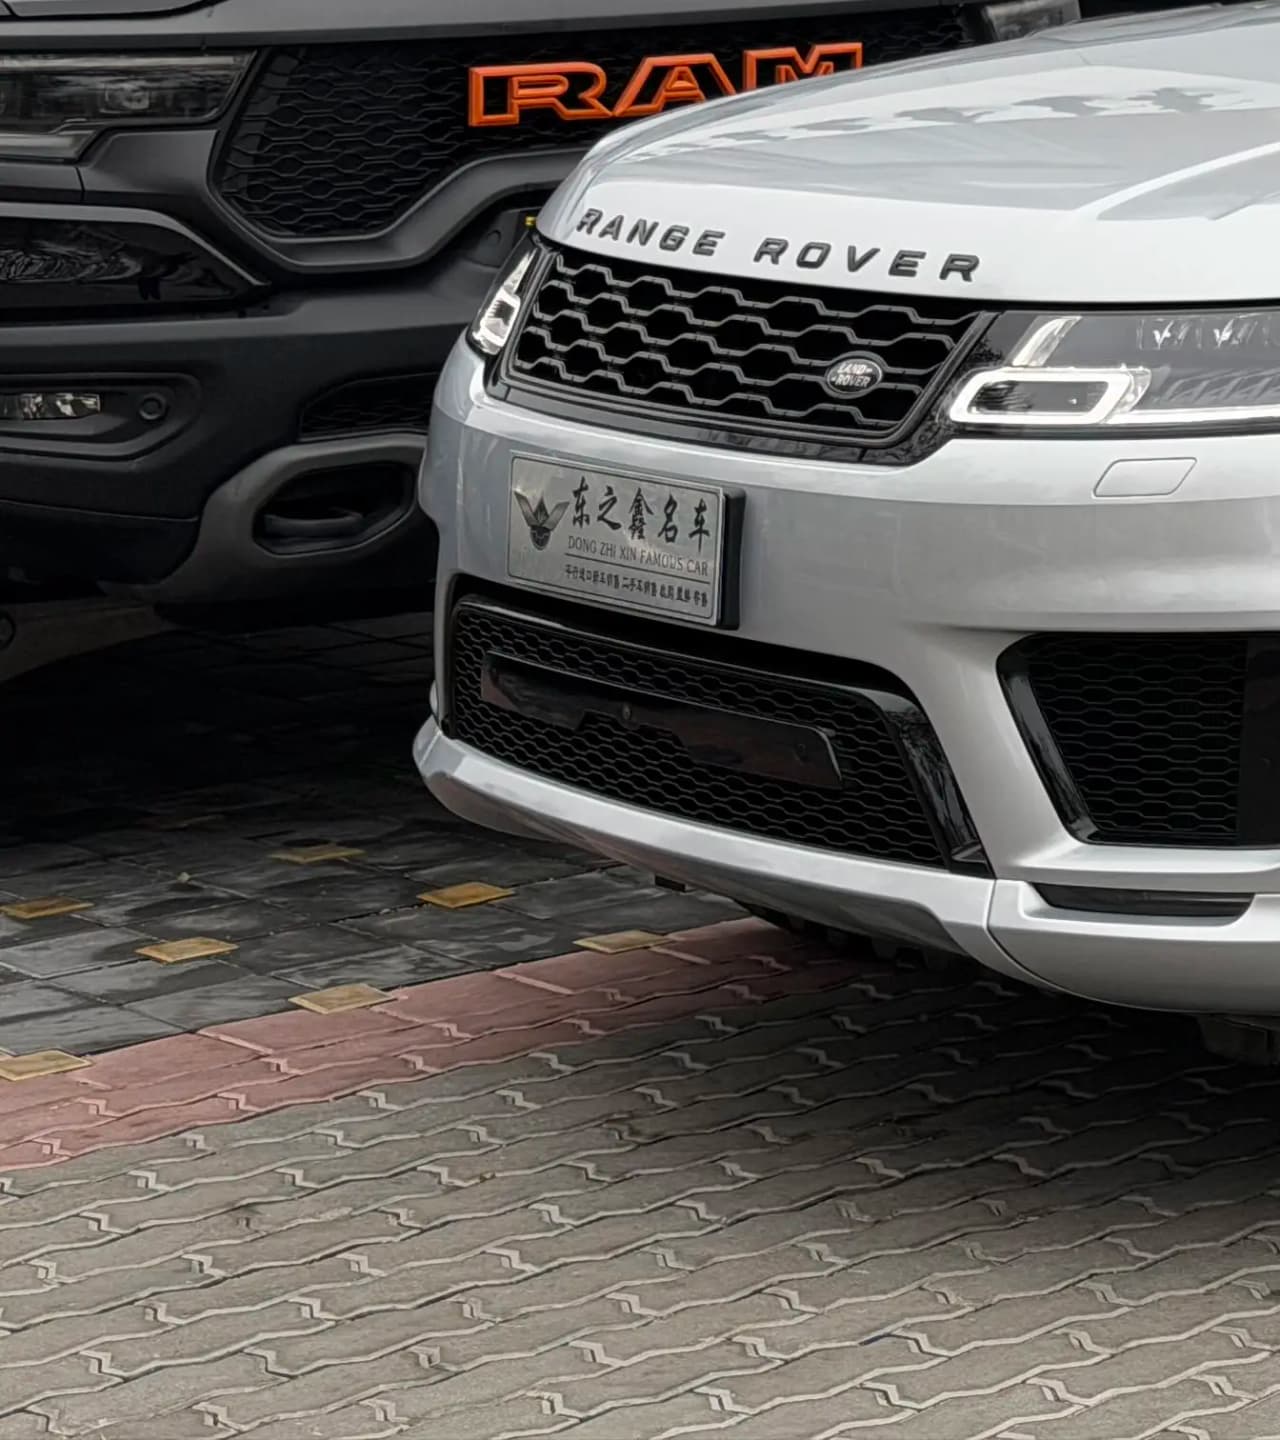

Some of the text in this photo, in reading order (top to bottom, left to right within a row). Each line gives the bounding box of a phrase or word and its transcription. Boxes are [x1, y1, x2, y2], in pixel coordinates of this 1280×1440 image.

[468, 42, 864, 127] RAM
[576, 208, 980, 283] RANGE ROVER
[572, 475, 711, 553] 东之鑫名车
[567, 535, 597, 554] DONG
[620, 544, 638, 561] XIN
[640, 548, 684, 571] FAMOUS
[686, 559, 709, 577] CAR
